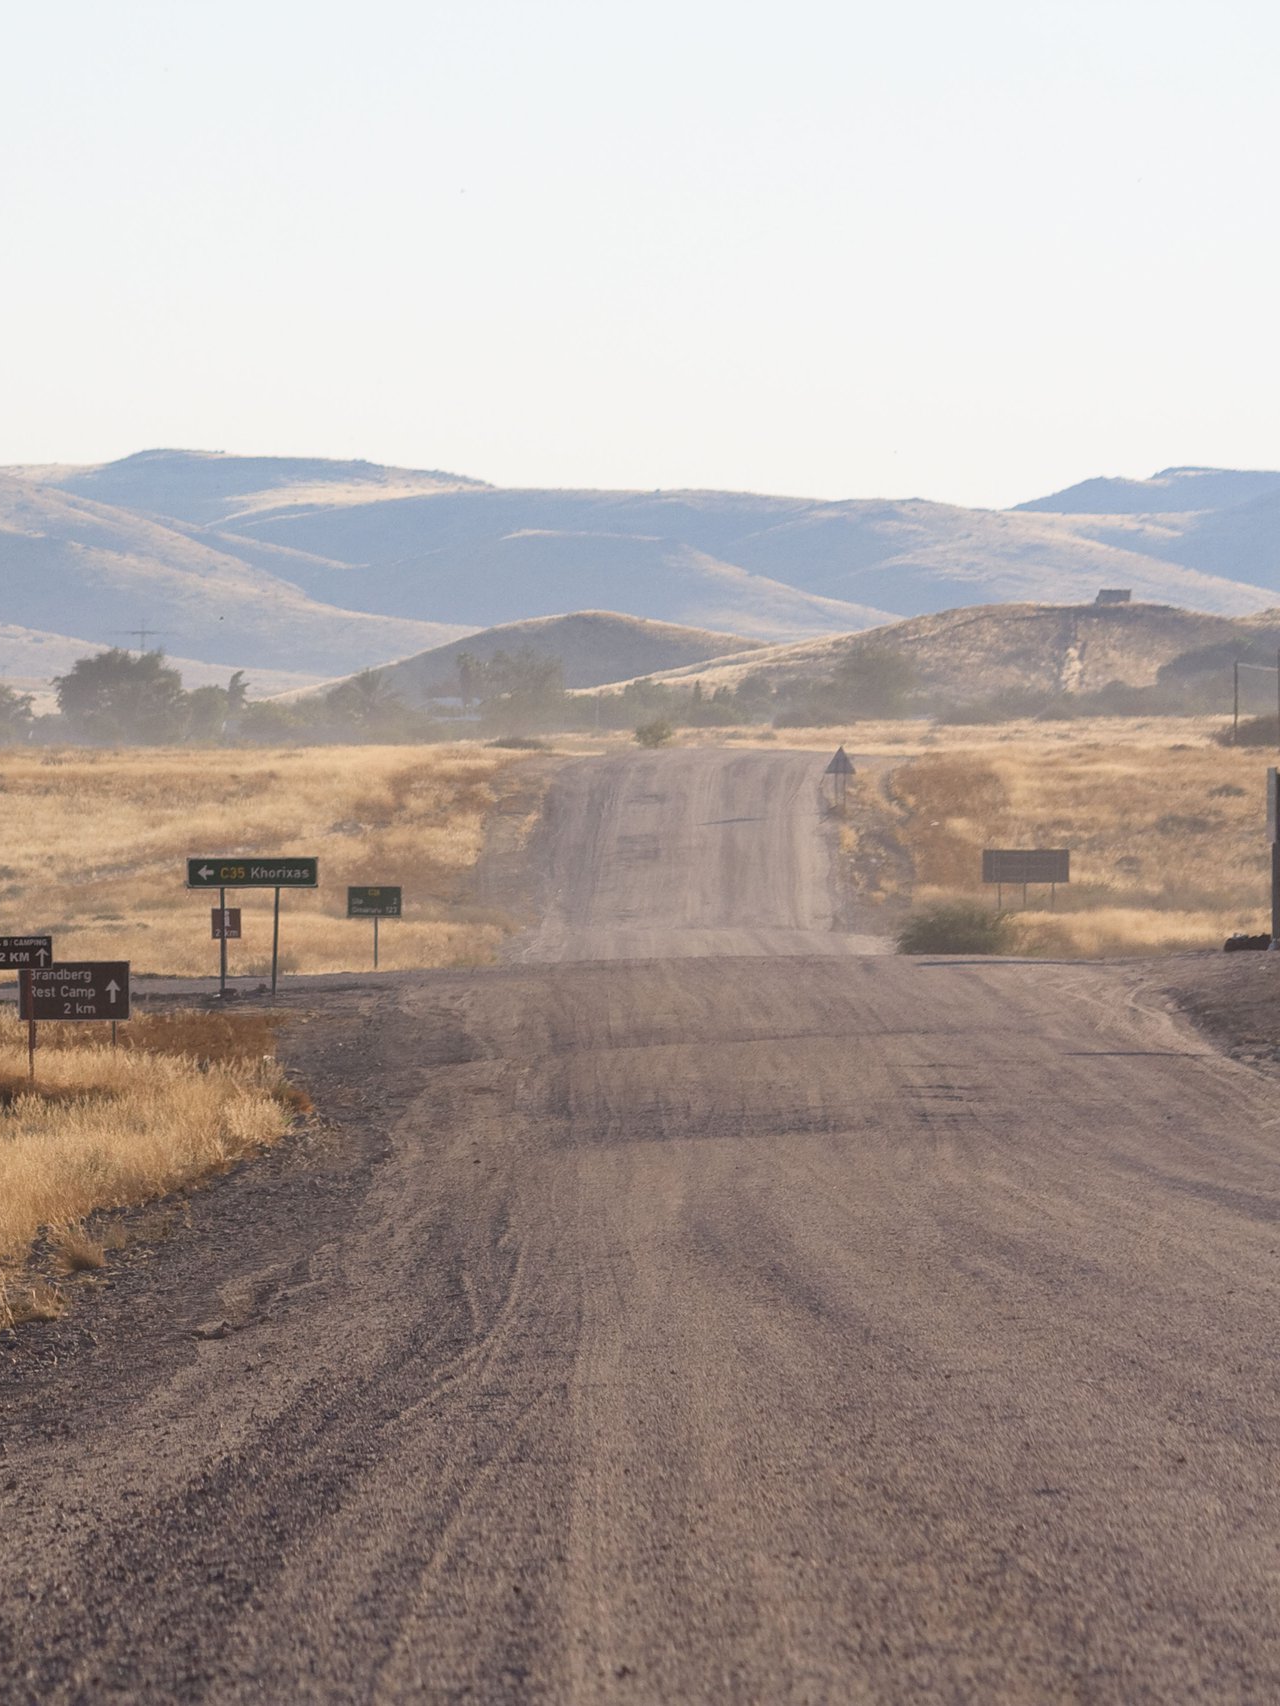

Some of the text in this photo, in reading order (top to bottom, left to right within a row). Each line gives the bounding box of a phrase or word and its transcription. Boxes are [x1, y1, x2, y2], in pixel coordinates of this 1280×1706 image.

[220, 866, 310, 879] C35 Khorixas
[13, 938, 48, 947] CAMPING
[9, 952, 30, 962] KM
[31, 985, 96, 999] Rest Camp
[63, 1002, 96, 1014] 2 km
